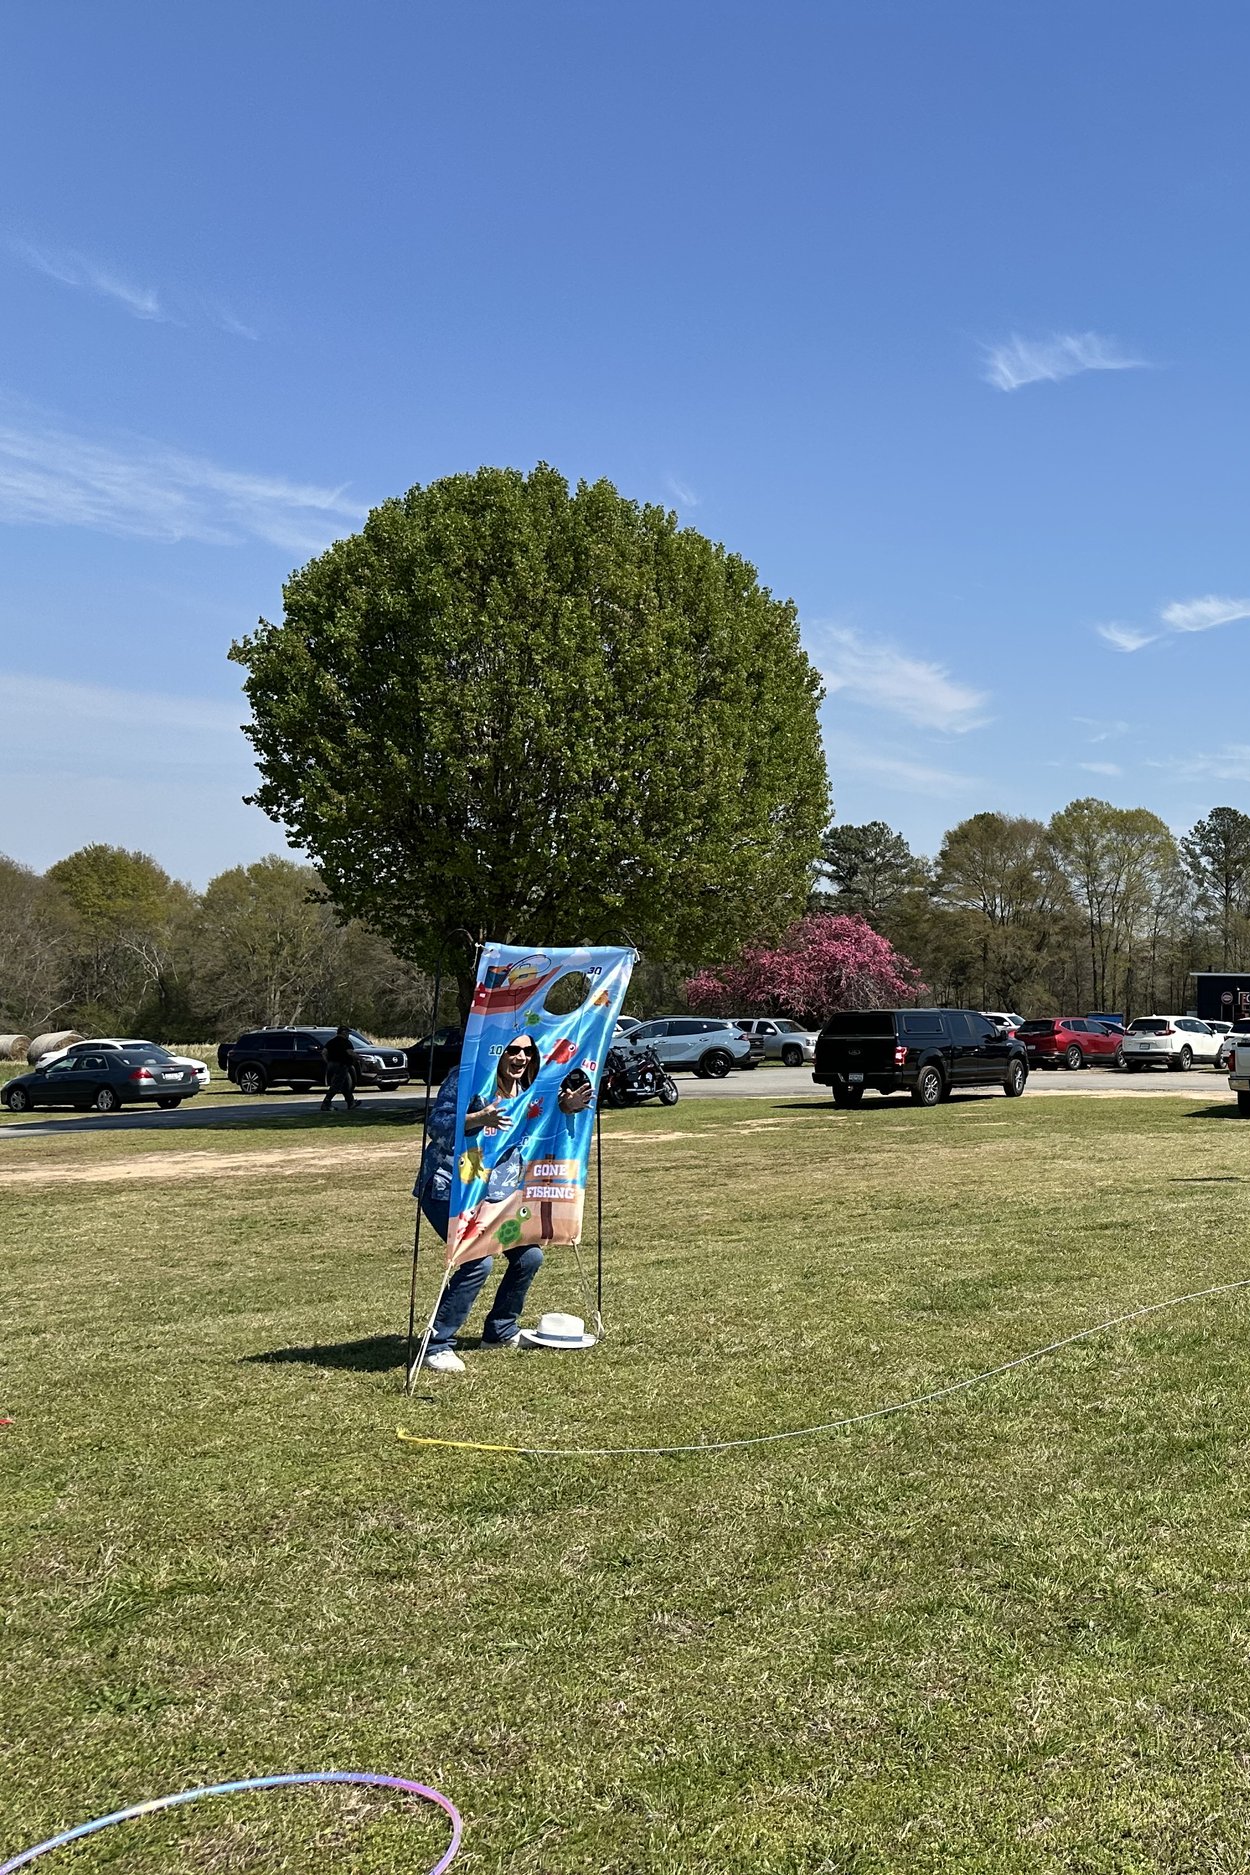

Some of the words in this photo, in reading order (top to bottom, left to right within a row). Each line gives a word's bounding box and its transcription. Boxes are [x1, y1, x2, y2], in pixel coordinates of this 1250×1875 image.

[587, 966, 602, 976] 30
[488, 1044, 504, 1056] 10
[581, 1058, 597, 1071] 40
[483, 1125, 498, 1137] 50
[533, 1163, 569, 1177] GONE
[525, 1185, 576, 1199] FISHING
